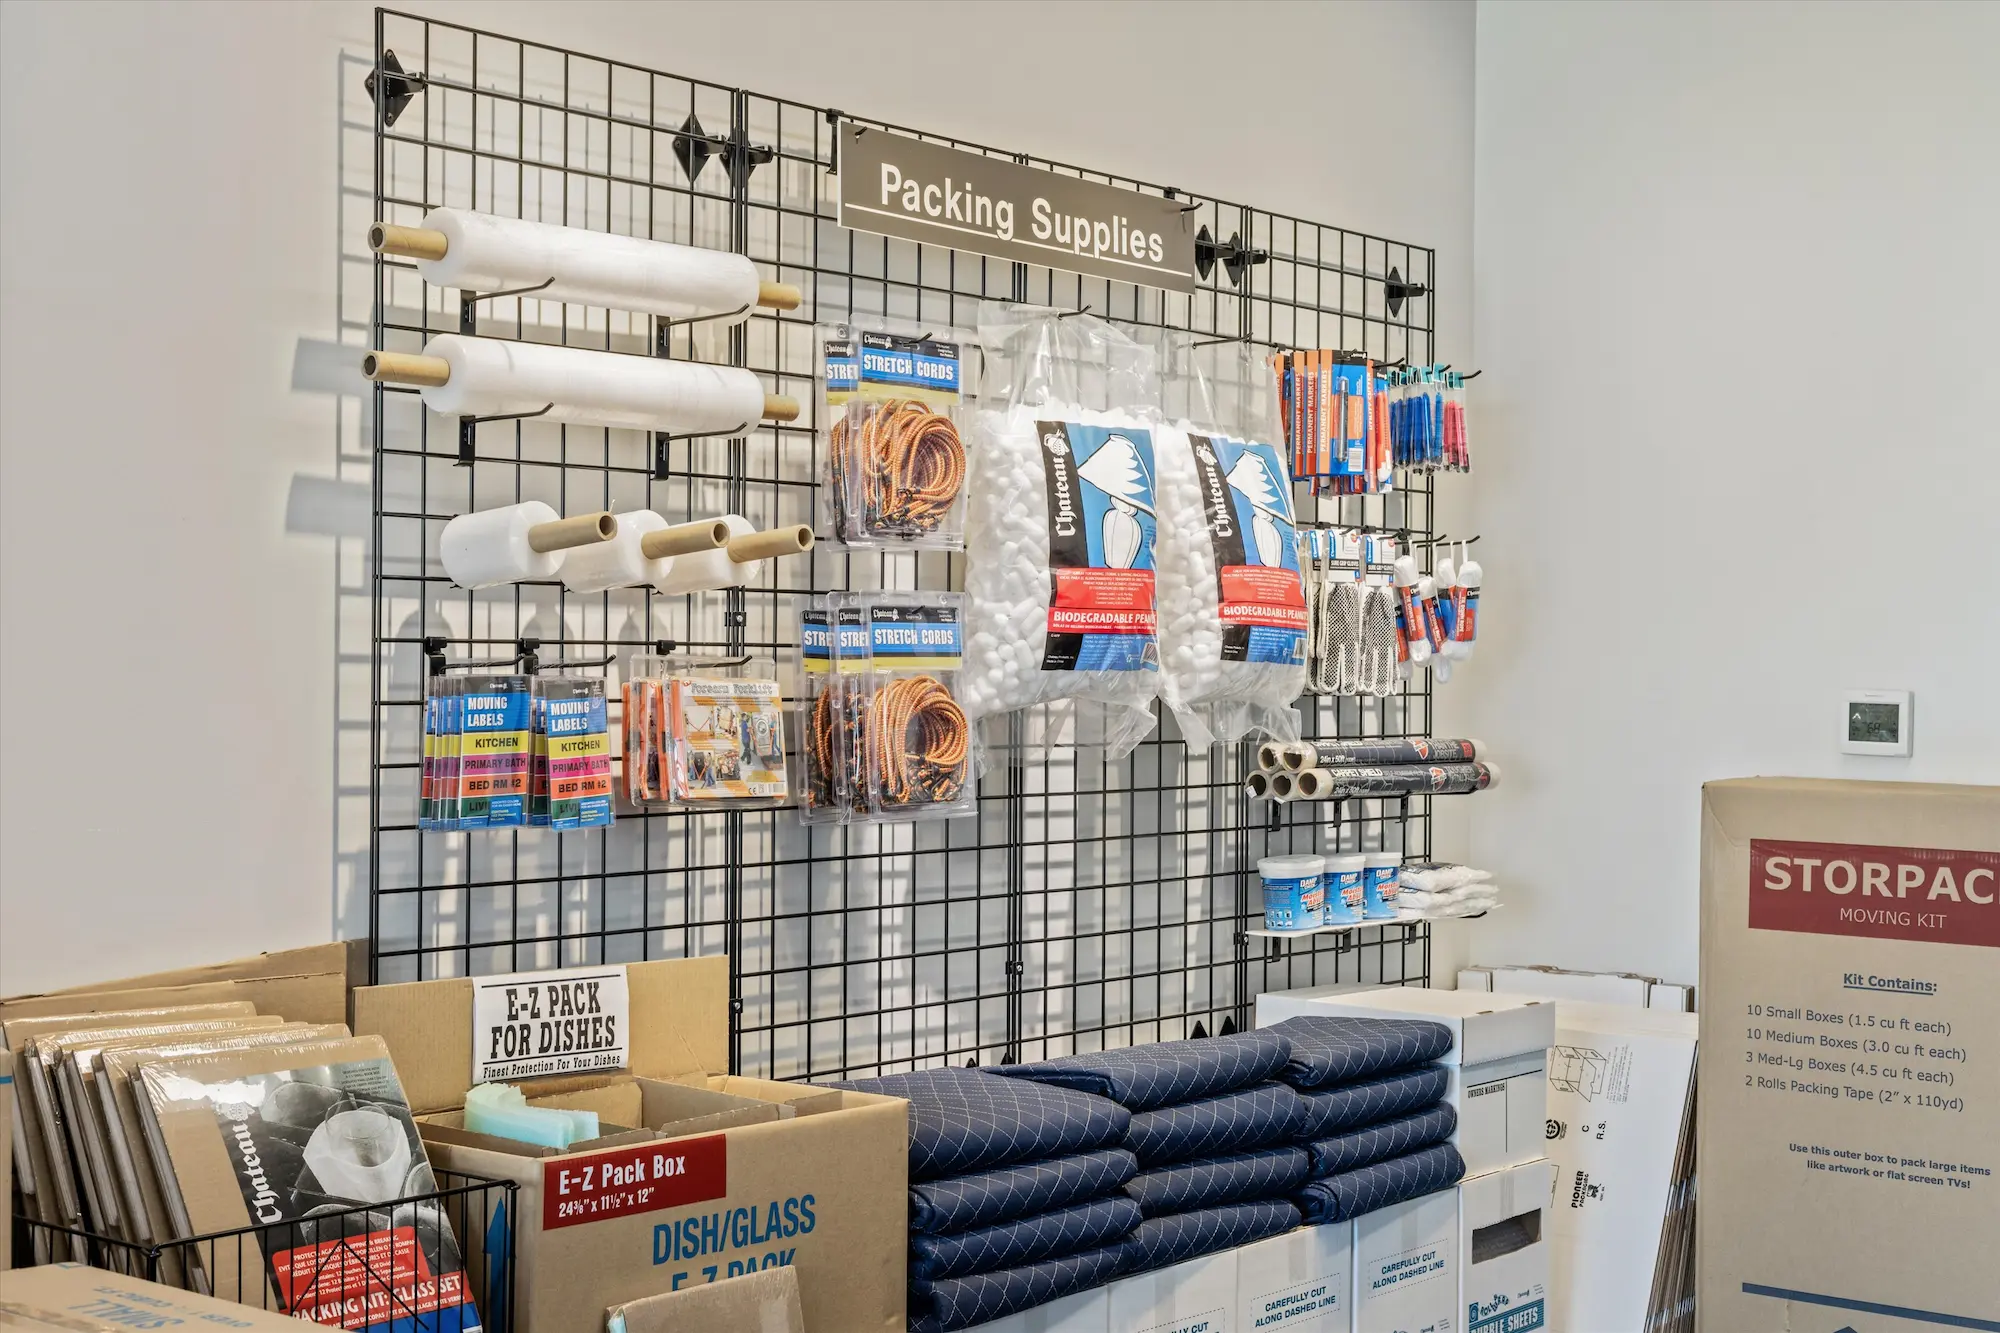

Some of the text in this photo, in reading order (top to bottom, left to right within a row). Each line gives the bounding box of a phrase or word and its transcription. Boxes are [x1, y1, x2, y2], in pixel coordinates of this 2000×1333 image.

[881, 162, 1163, 262] Packing Supplies
[827, 364, 858, 380] STRET
[864, 354, 953, 380] STRETCH CORDS
[1055, 457, 1077, 537] Chateau
[1053, 611, 1133, 623] BIODEGRADABLE
[1223, 606, 1287, 618] BIODEGRADABLE
[875, 629, 954, 645] STRETCH CORDS
[468, 697, 507, 710] MOVING
[551, 702, 589, 716] MOVING
[468, 714, 504, 727] LABELS
[552, 718, 588, 732] LABELS
[475, 737, 518, 748] KITCHEN
[561, 740, 600, 752] KITCHEN
[465, 757, 526, 770] PRIMARY BATH
[553, 761, 589, 773] PRIMARY
[469, 779, 489, 790] BED
[493, 780, 508, 789] RM
[558, 783, 578, 793] BED
[581, 782, 595, 791] RM
[469, 801, 489, 812] LIVI
[1764, 856, 2000, 904] STORPAC
[1840, 908, 1947, 929] MOVING KIT
[1844, 973, 1938, 992] Kit Contains:
[506, 982, 601, 1021] E-Z PACK
[1747, 1005, 1952, 1036] 10 Small Boxes (1.5 cu ft each)
[490, 1015, 615, 1059] FOR DISHES
[1747, 1028, 1967, 1063] 10 Medium Boxes (3.0 cu ft each)
[483, 1054, 621, 1079] Finest Protection For Your Dishes
[1746, 1052, 1954, 1086] 3 Med-Lg Boxes (4.5 cu ft each)
[1485, 1083, 1505, 1095] MARKINGS
[1745, 1076, 1964, 1113] 2 Rolls Packing Tape (2" x 110yd)
[1582, 1125, 1590, 1133] C
[1596, 1120, 1607, 1140] R.S.
[1789, 1143, 1991, 1176] Use this outer box to pack large items
[232, 1124, 283, 1224] Chateau
[559, 1154, 686, 1195] E-Z Pack Box
[1807, 1160, 1971, 1189] like artwork or flat screen TVs!
[1571, 1170, 1584, 1208] PIONEER
[1579, 1173, 1589, 1207] PACKAGING
[591, 1202, 598, 1213] x
[627, 1196, 634, 1206] x
[653, 1194, 816, 1266] DISH/GLASS
[1381, 1251, 1436, 1275] CAREFULLY CUT
[440, 1275, 461, 1293] SET
[1372, 1260, 1445, 1290] ALONG DASHED LINE
[1265, 1286, 1327, 1312] CAREFULLY CUT
[1255, 1295, 1336, 1328] ALONG DASHED LINE
[1508, 1307, 1539, 1332] SHEETS
[1191, 1321, 1209, 1333] CUT
